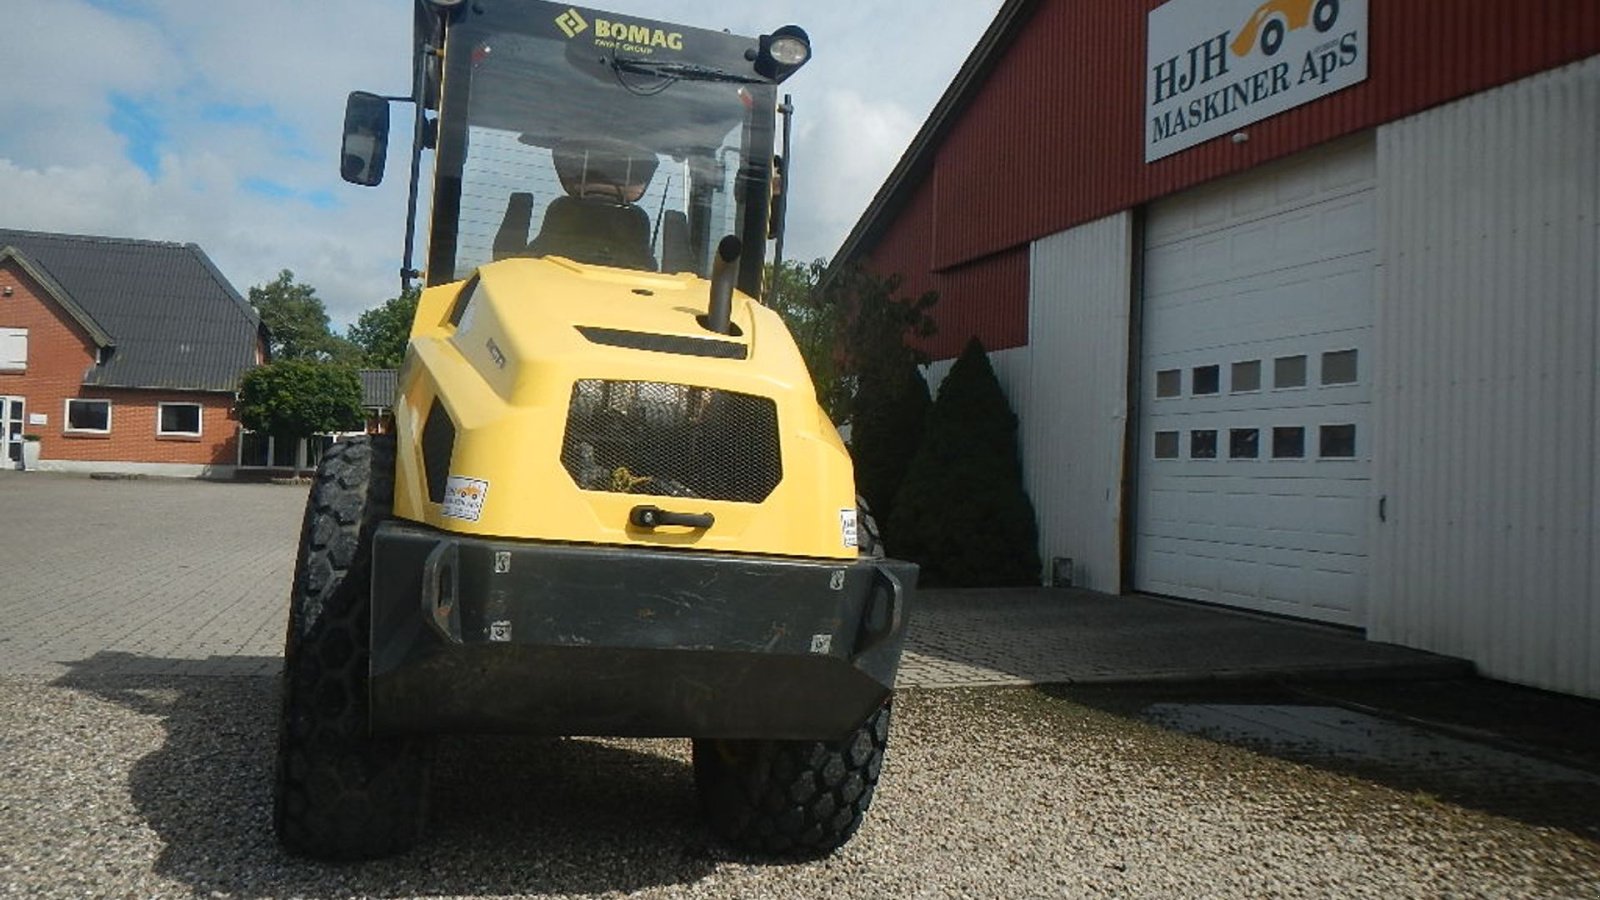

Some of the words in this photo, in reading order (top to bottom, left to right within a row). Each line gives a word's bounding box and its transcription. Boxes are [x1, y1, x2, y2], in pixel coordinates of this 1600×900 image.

[595, 18, 682, 50] BOMAG
[1152, 30, 1231, 106] HJH
[1152, 61, 1289, 143] MASKINER
[1297, 30, 1358, 85] ApS
